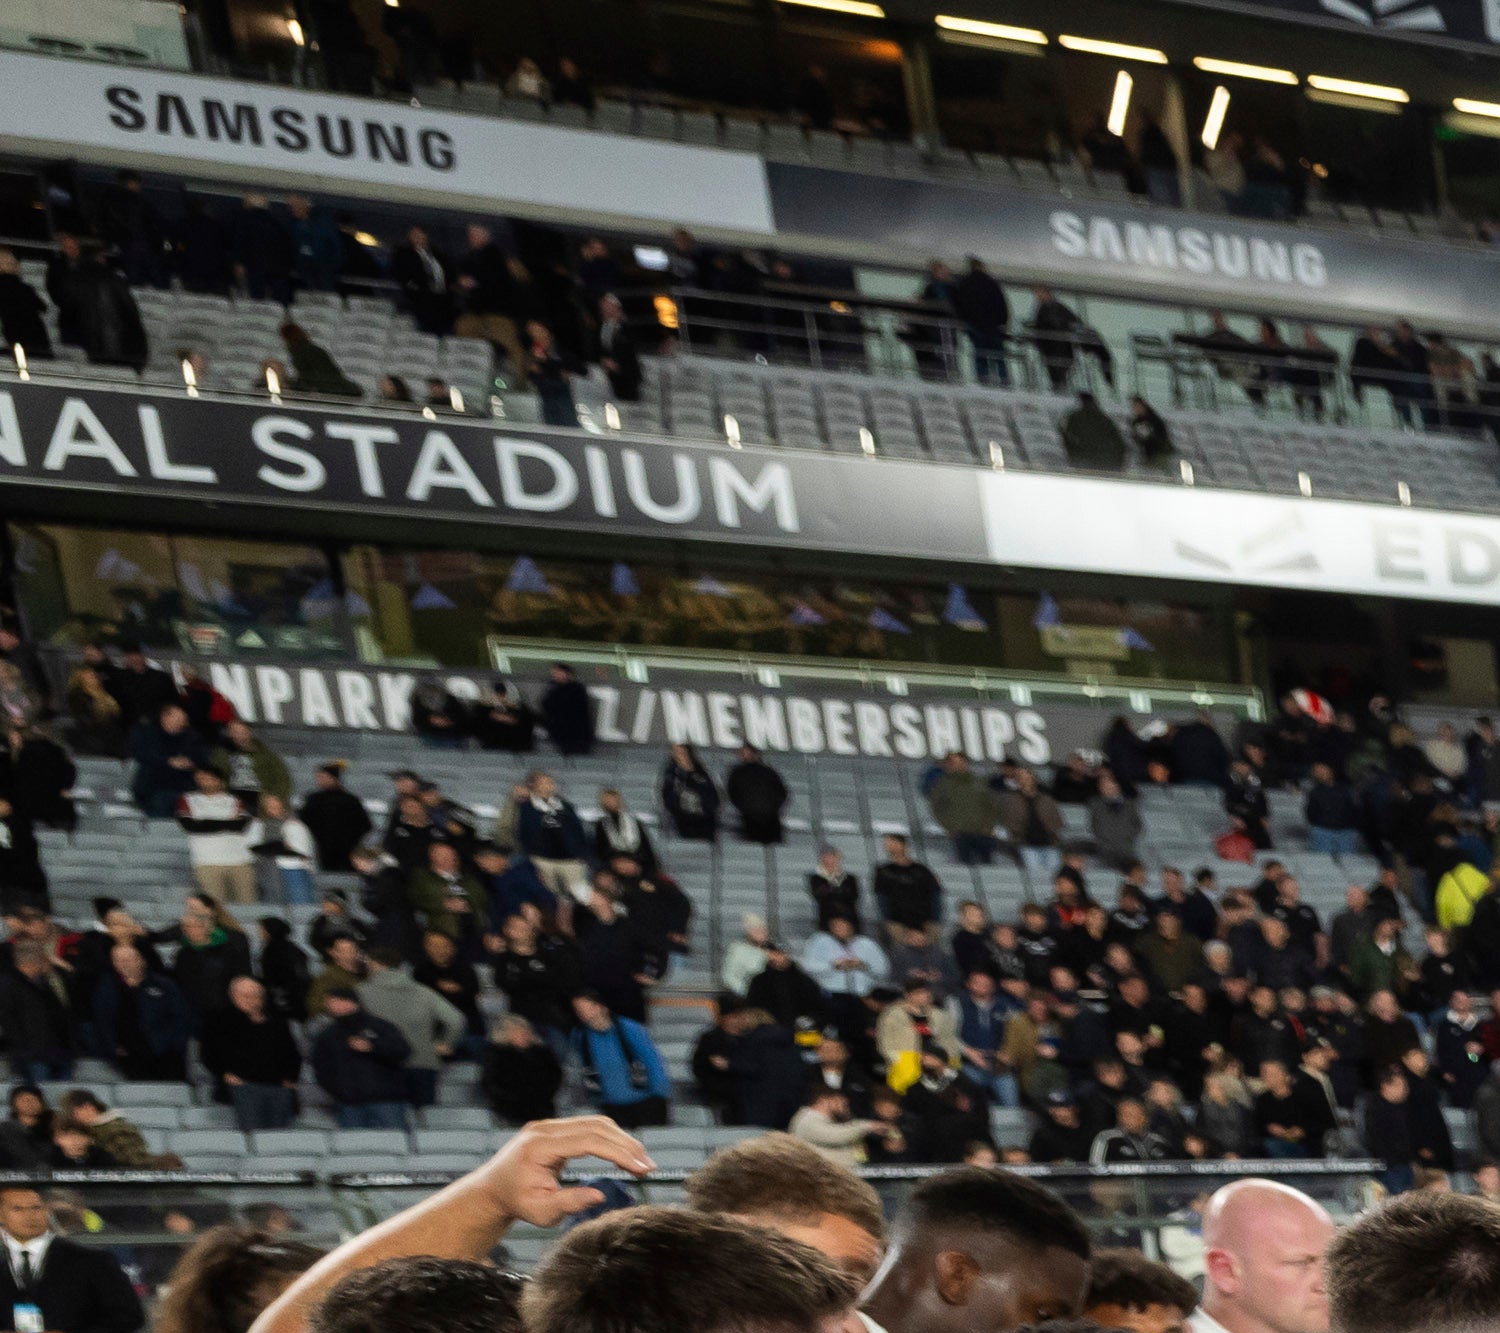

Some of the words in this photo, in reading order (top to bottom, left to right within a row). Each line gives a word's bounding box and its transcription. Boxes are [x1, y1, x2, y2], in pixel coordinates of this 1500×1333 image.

[104, 84, 456, 171] SAMSUNG
[1048, 210, 1328, 288] SAMSUNG
[250, 412, 800, 535] STADIUM
